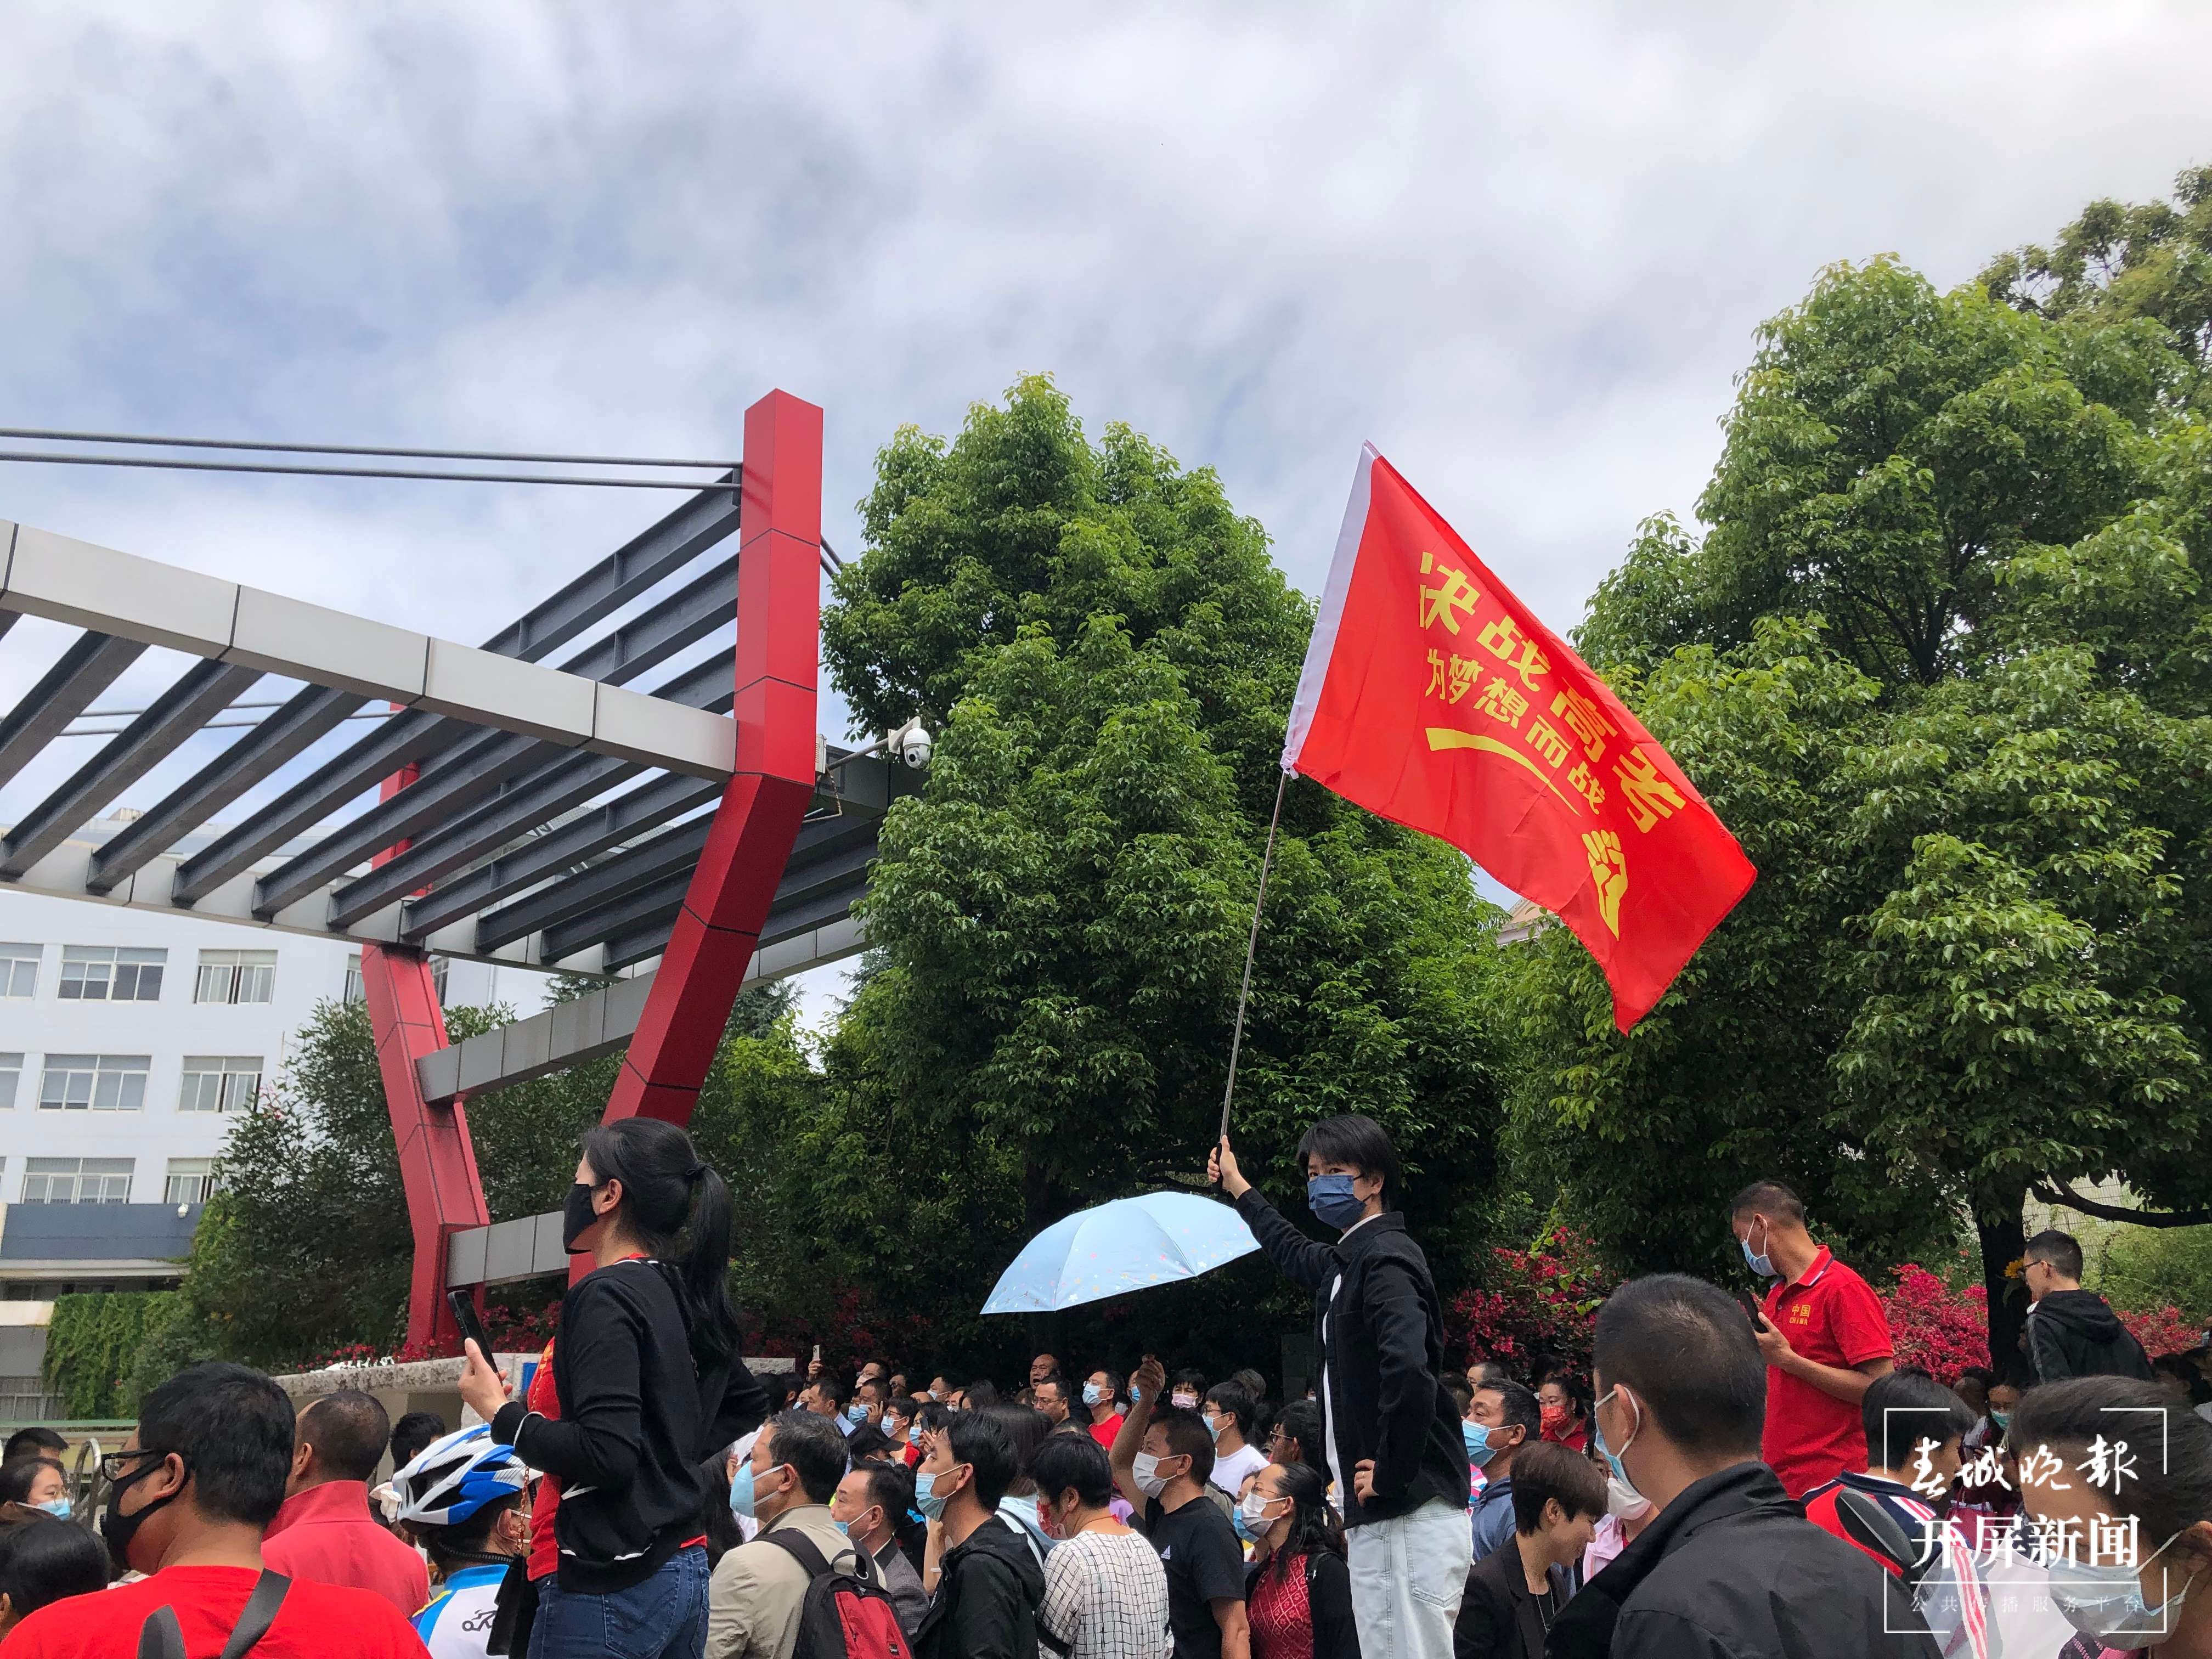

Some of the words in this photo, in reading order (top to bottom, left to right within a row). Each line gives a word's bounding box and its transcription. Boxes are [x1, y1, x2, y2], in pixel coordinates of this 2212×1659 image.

[1419, 552, 1686, 833] 决战高考
[1425, 648, 1605, 815] 为梦想而战
[1789, 1317, 1808, 1325] CHINA
[1791, 1304, 1811, 1317] 中国
